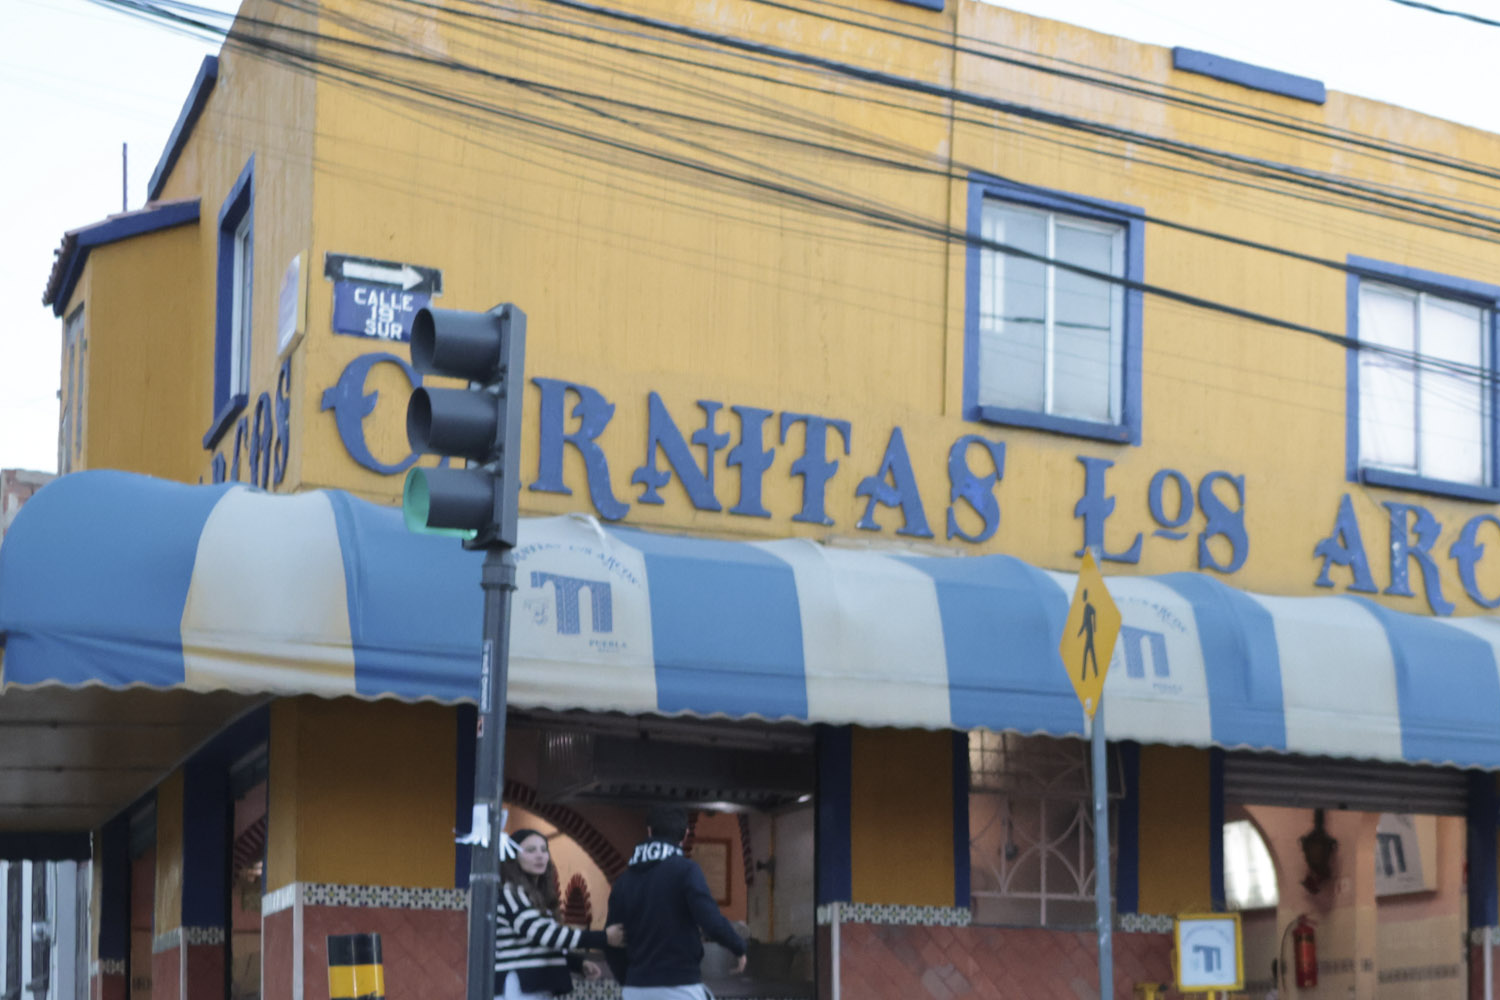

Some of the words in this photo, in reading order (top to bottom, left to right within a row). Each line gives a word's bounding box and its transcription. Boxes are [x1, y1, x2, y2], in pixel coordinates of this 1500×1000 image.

[354, 287, 414, 313] CALLE
[364, 317, 404, 340] SUR
[320, 351, 1007, 545] CRNITAS
